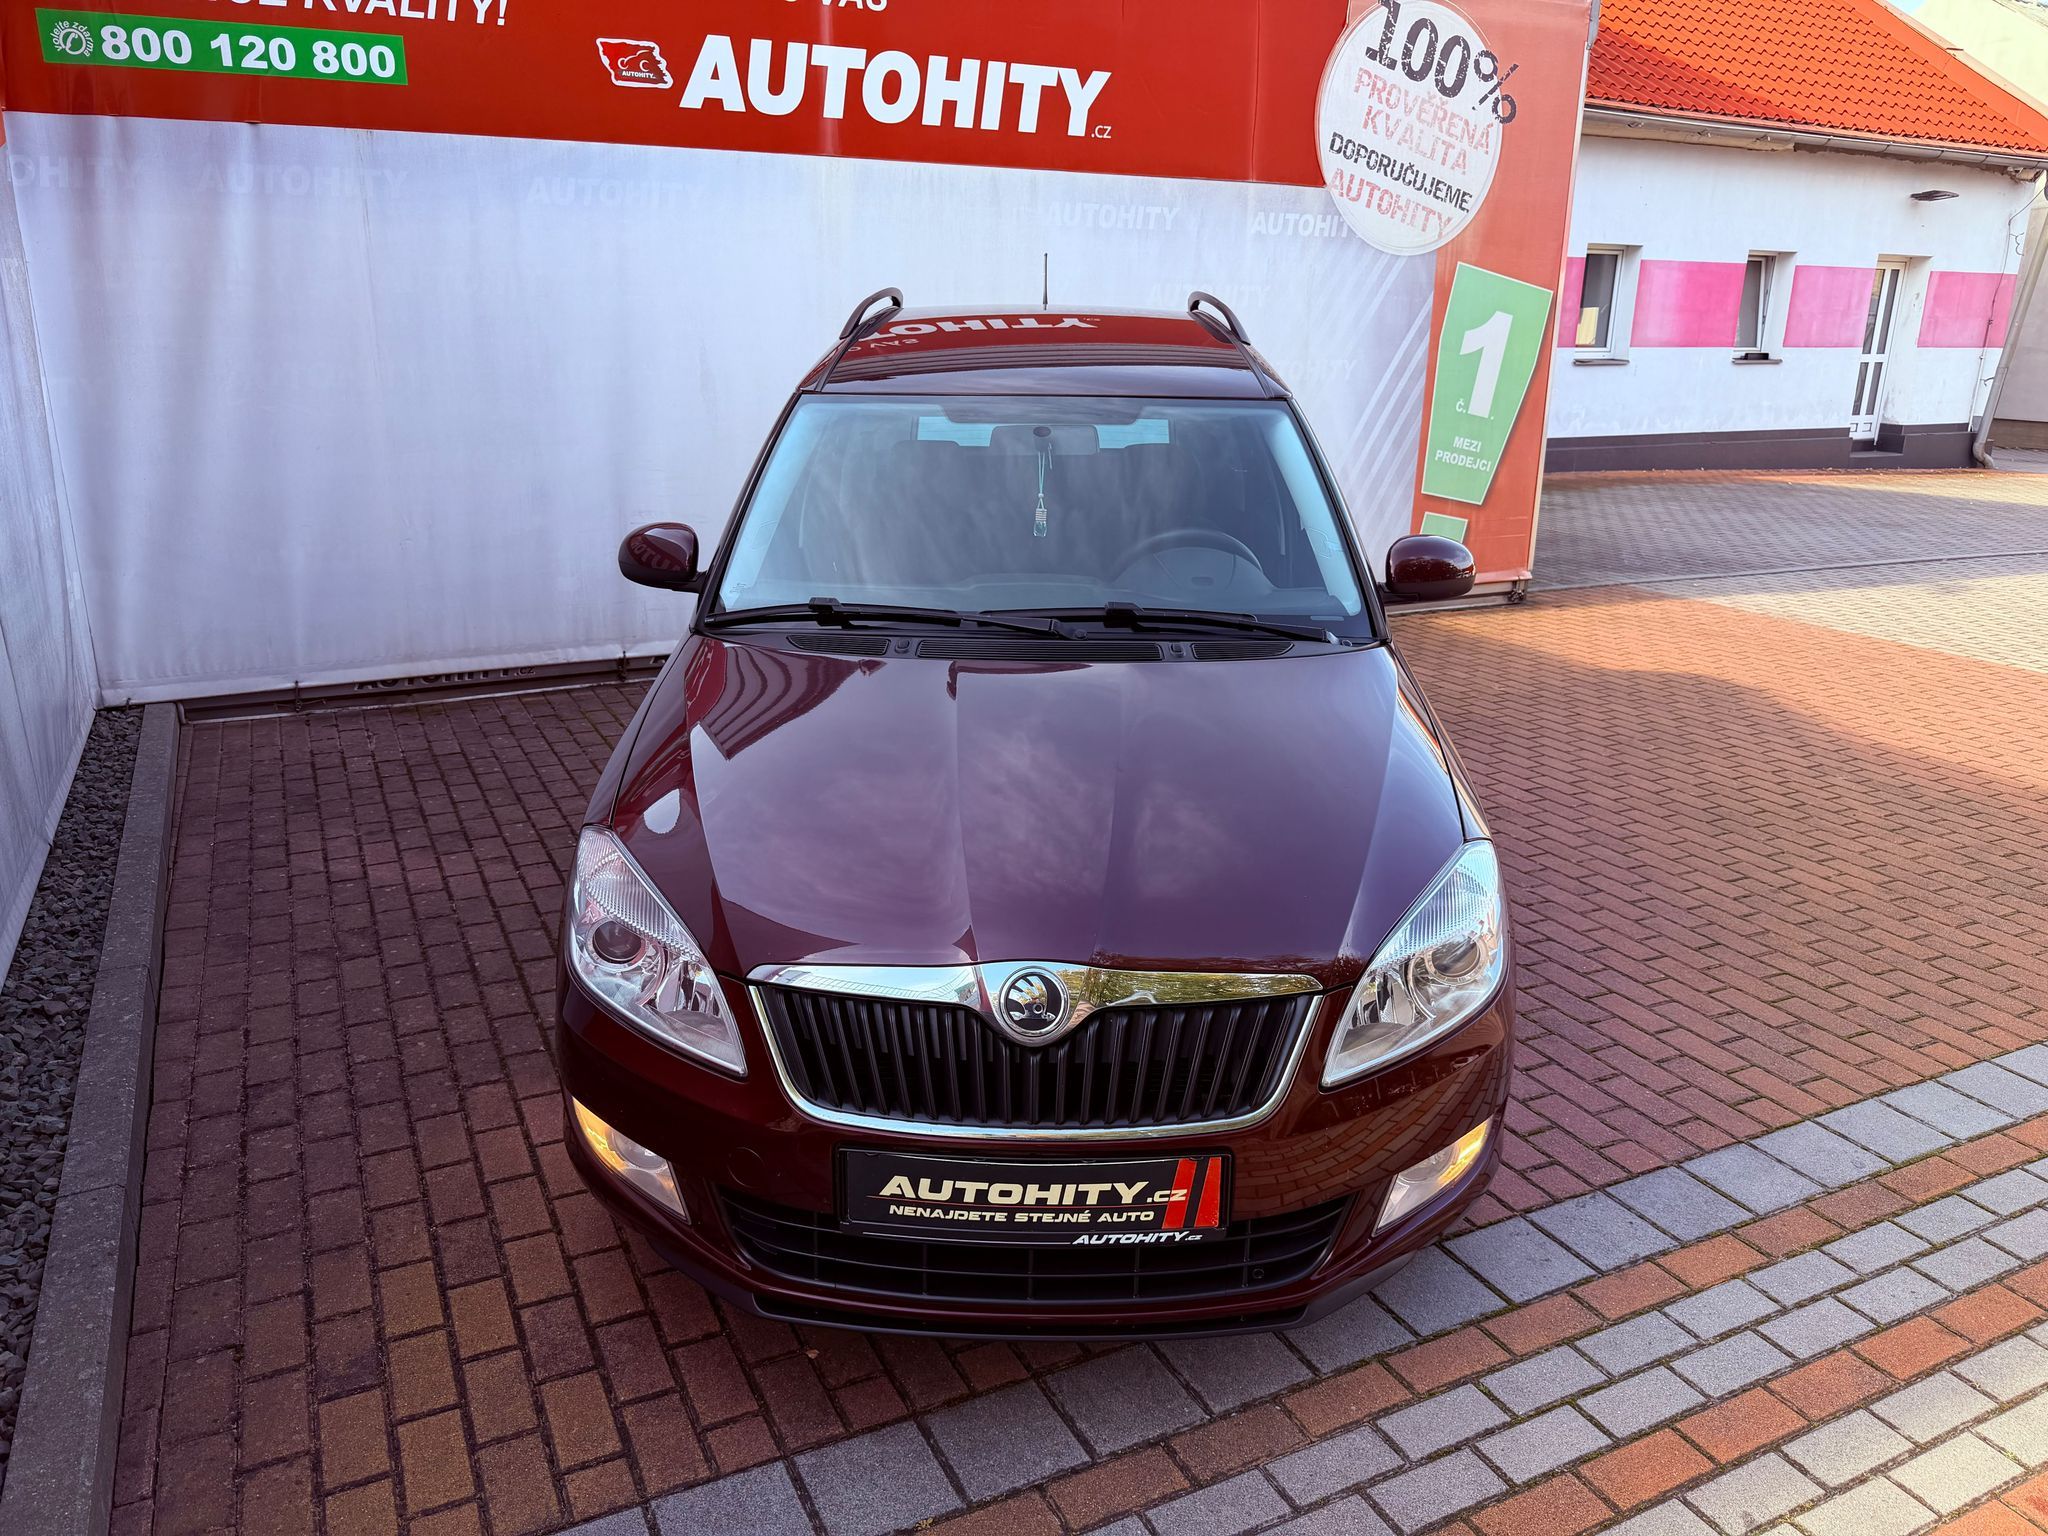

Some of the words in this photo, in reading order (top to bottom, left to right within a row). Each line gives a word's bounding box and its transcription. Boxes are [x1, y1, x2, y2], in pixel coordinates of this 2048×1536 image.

[50, 21, 70, 51] volejte
[72, 22, 93, 57] zdarma
[100, 25, 192, 64] 800
[210, 33, 296, 71] 120
[312, 40, 396, 78] 800
[1365, 0, 1519, 124] 100%
[1354, 67, 1493, 155] PROVĚŘENÁ
[1362, 105, 1468, 175] KVALITA
[1329, 132, 1473, 213] DOPORUČUJEME
[1250, 211, 1360, 238] AUTOHIT
[1328, 168, 1453, 241] AUTOHITY
[1435, 450, 1492, 472] PRODEJCI
[1453, 436, 1482, 453] MEZI
[879, 1175, 1188, 1205] AUTOHITY.cz
[889, 1205, 1008, 1222] NENAJDETE
[1014, 1210, 1091, 1223] STEJNÉ
[1097, 1211, 1155, 1223] AUTO
